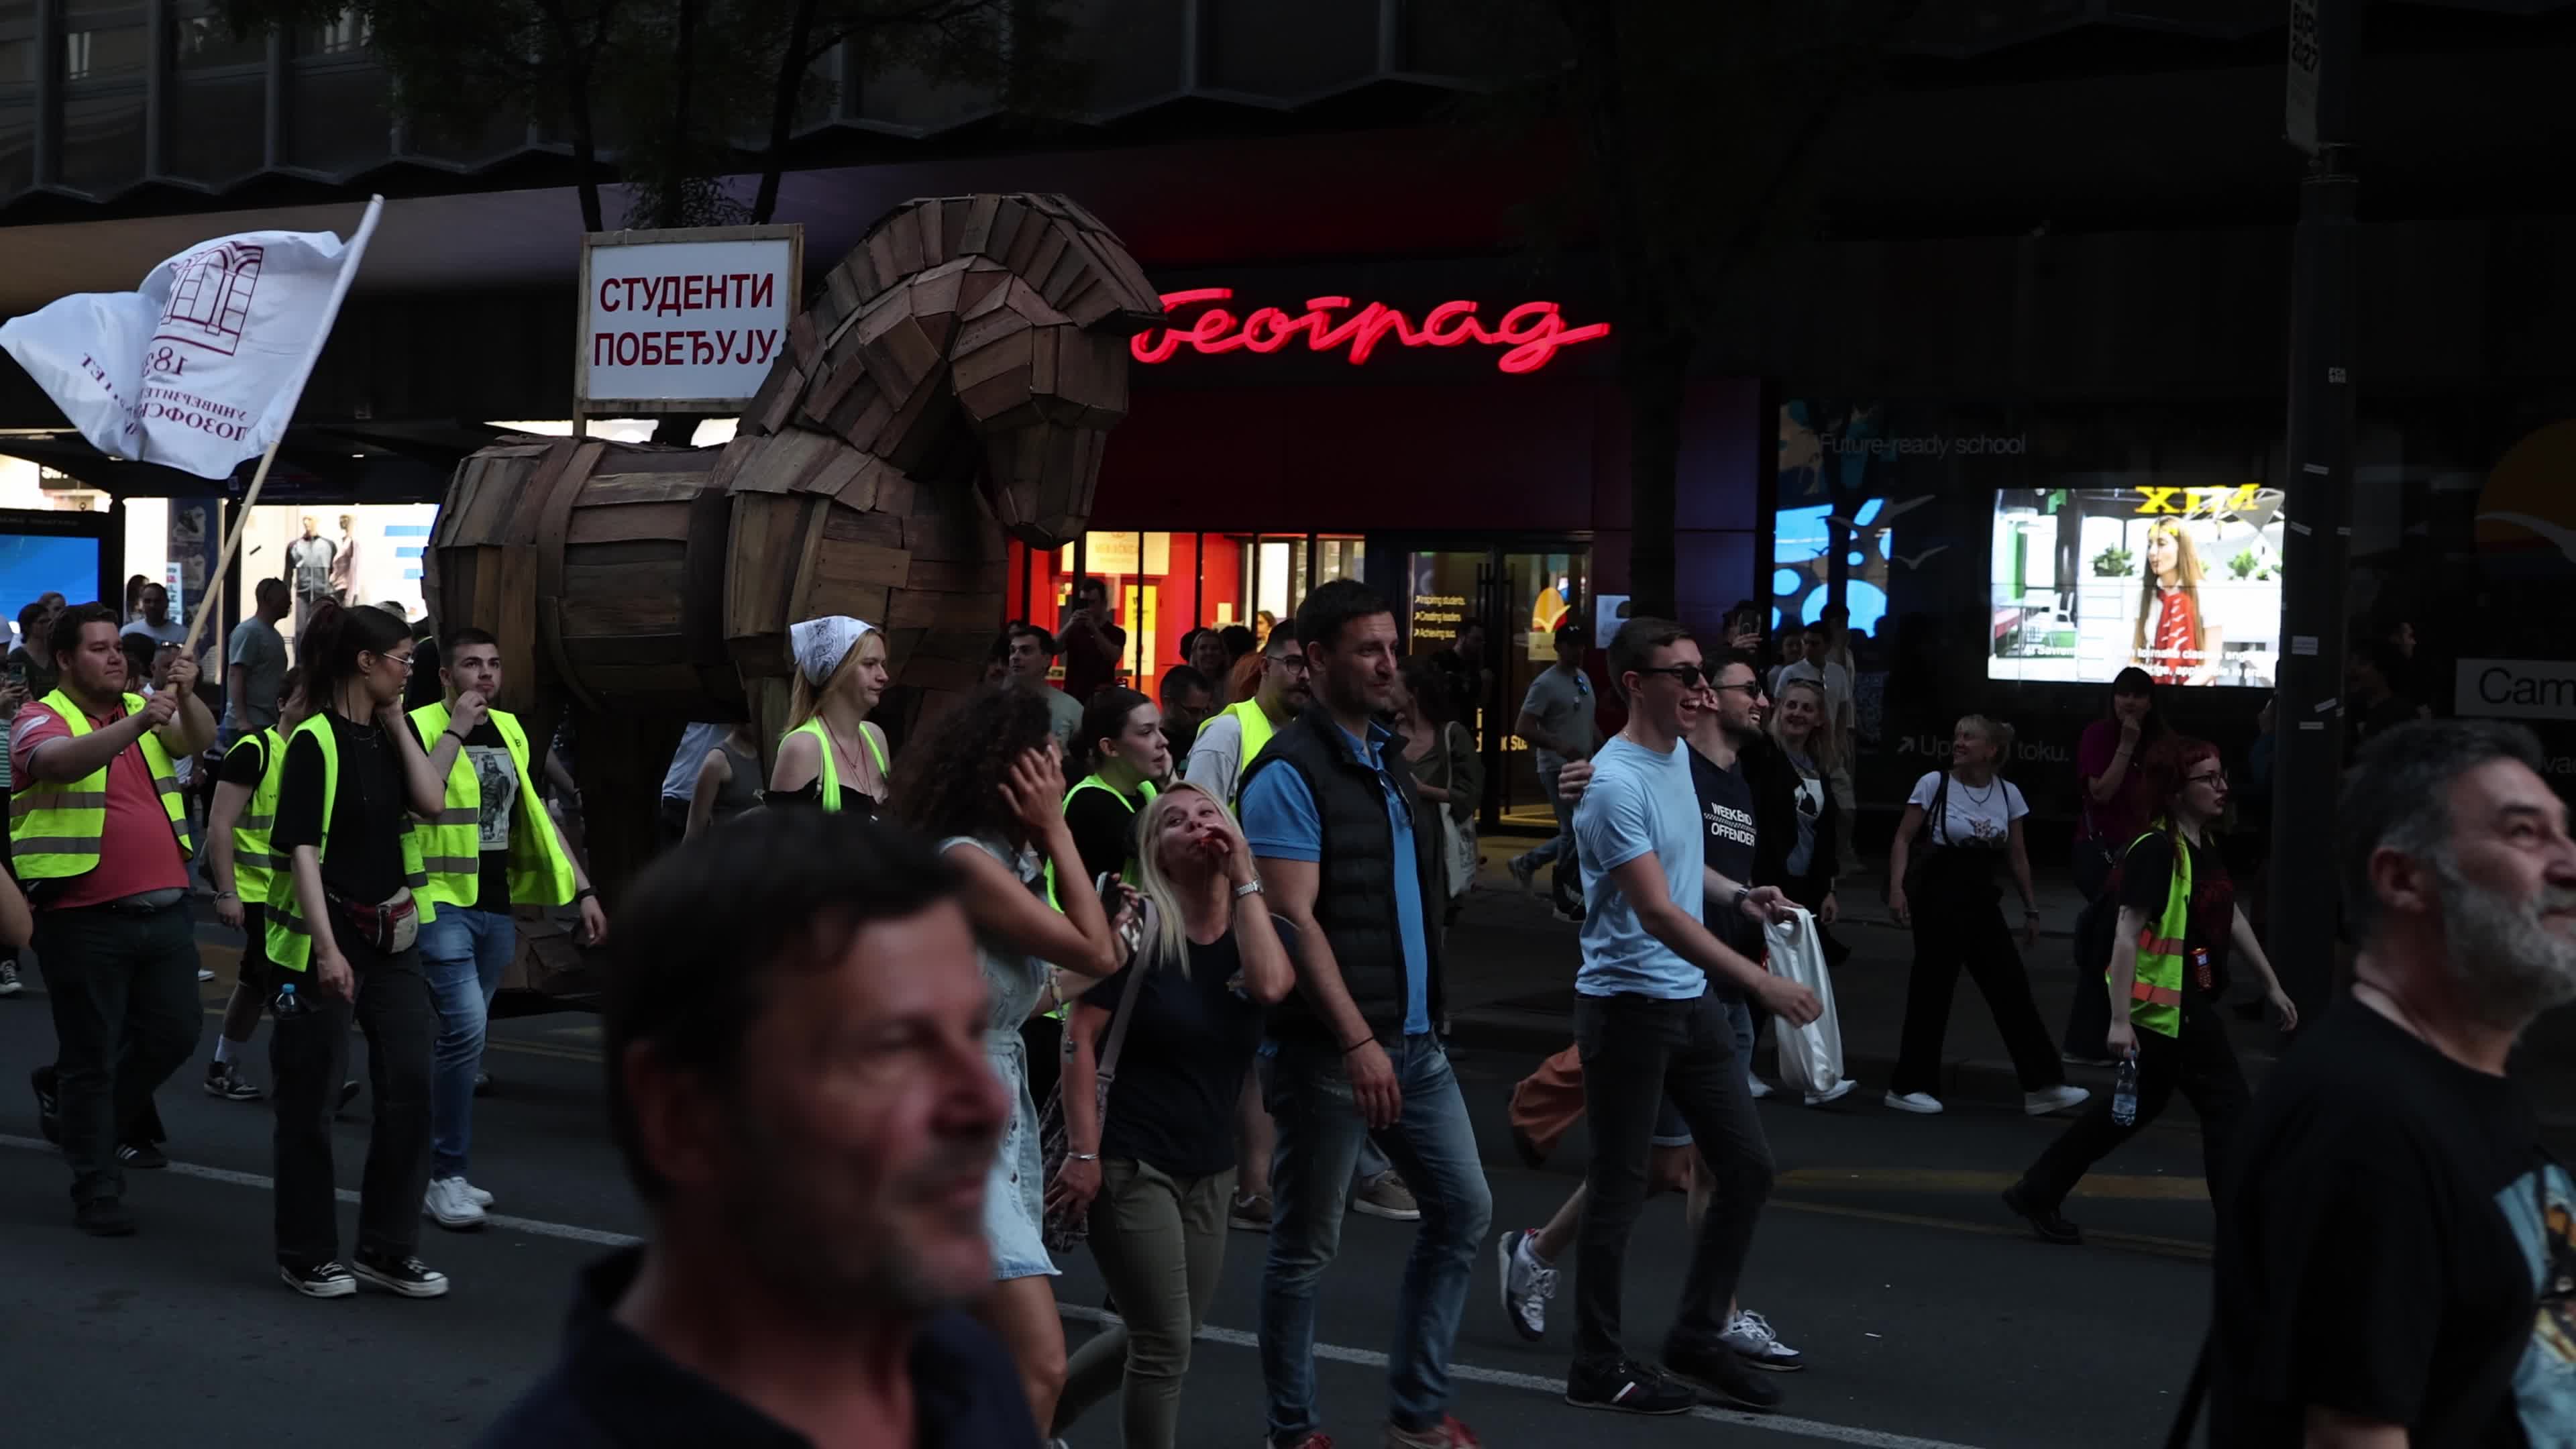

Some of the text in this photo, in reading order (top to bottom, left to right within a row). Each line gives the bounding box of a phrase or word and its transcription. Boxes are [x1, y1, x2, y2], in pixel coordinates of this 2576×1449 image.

[600, 273, 773, 317] СТУДЕНТИ
[594, 329, 777, 366] ПОБЕЂУЈУ
[1819, 431, 2027, 462] Future-ready school
[2479, 667, 2576, 705] Cam
[2017, 740, 2071, 763] toku.
[1711, 802, 1754, 826] WEEKEND
[1711, 822, 1756, 847] OFFENDER
